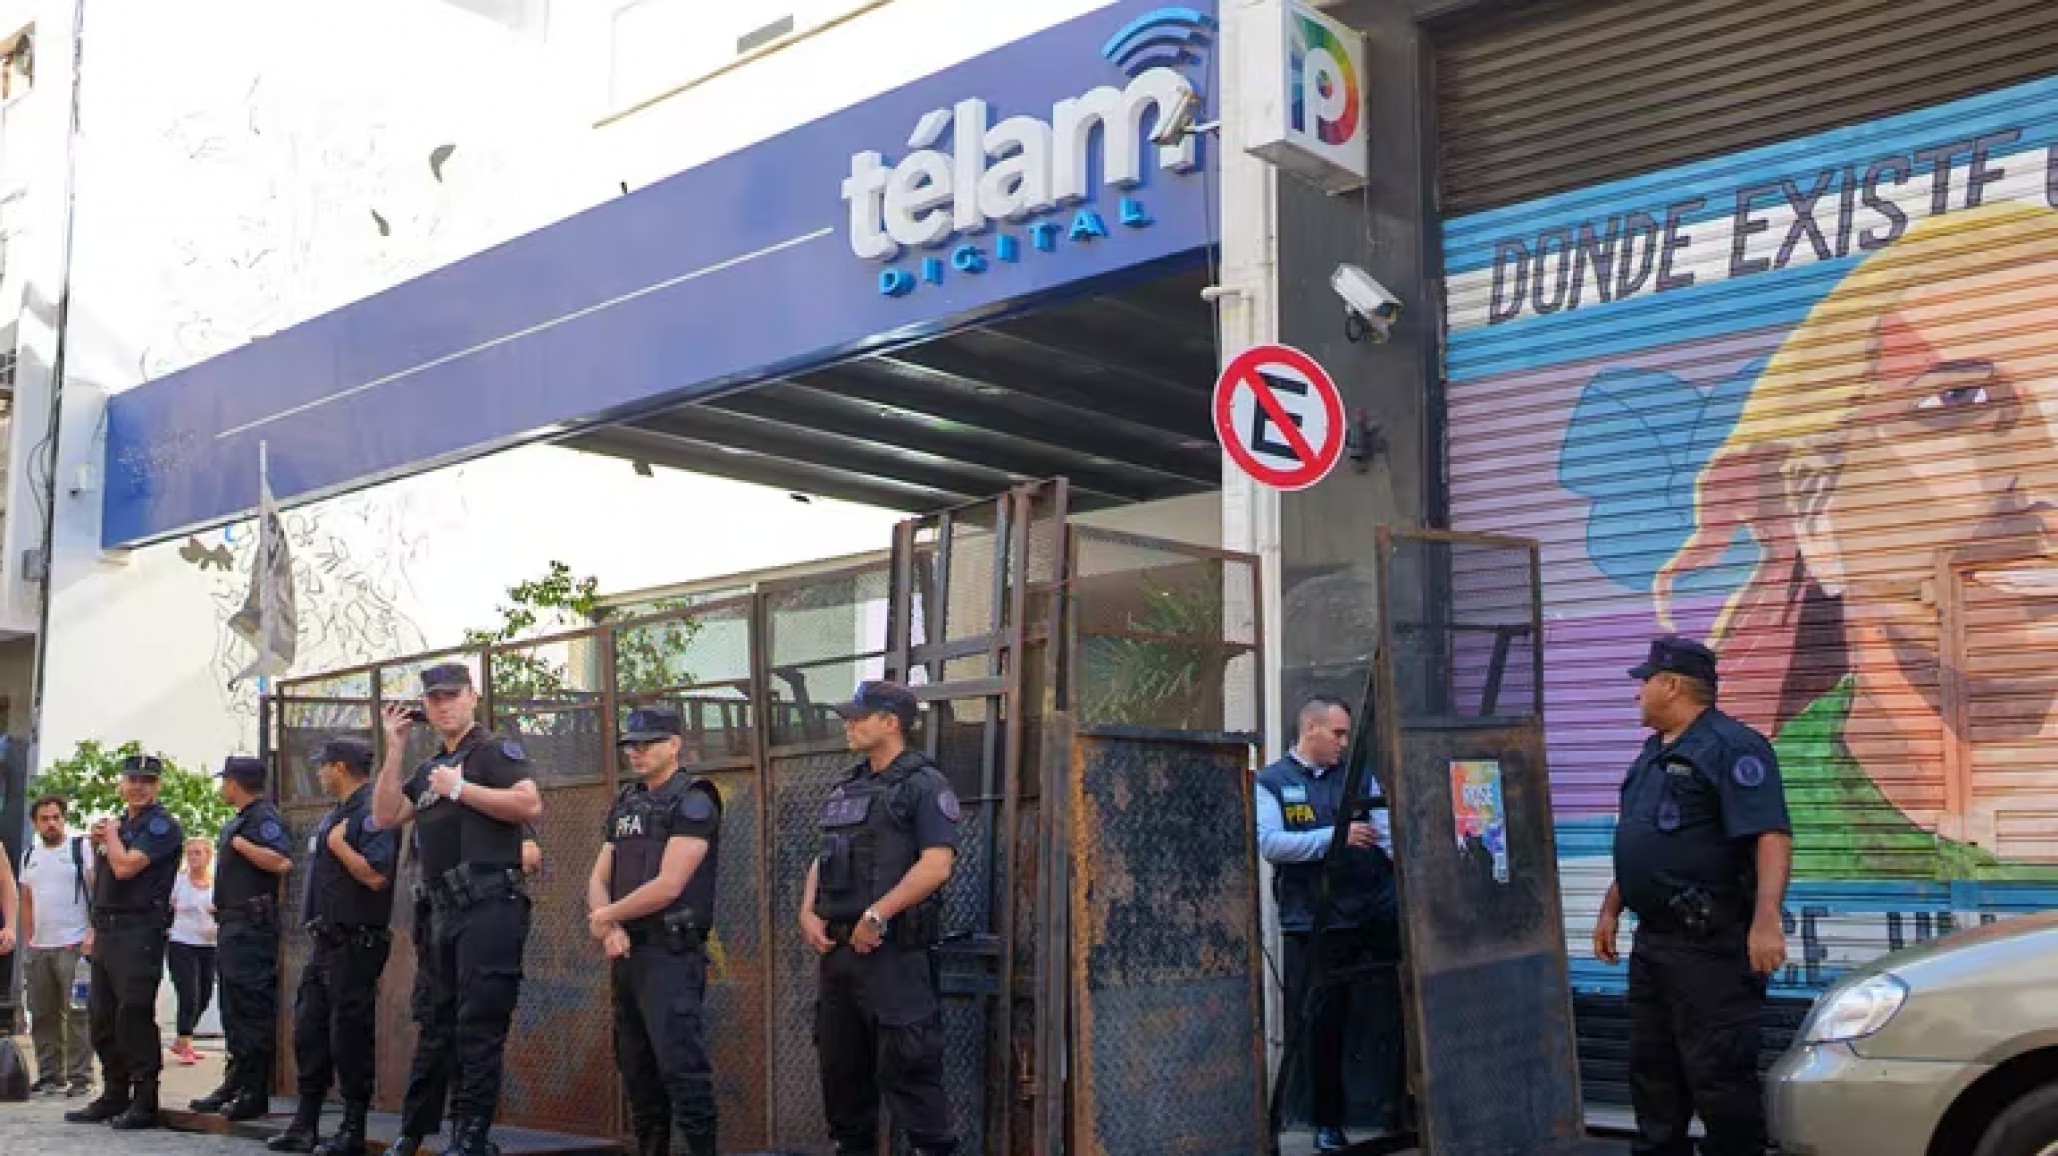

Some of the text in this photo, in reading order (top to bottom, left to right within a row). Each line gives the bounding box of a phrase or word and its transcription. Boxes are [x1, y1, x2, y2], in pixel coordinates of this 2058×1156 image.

[841, 66, 1197, 260] télam
[879, 196, 1157, 297] DIGITAL
[1487, 196, 1708, 325] DONDE
[1729, 127, 2024, 276] EXISTE
[1251, 372, 1308, 462] E
[615, 815, 643, 838] PFA
[1285, 804, 1317, 823] PFA
